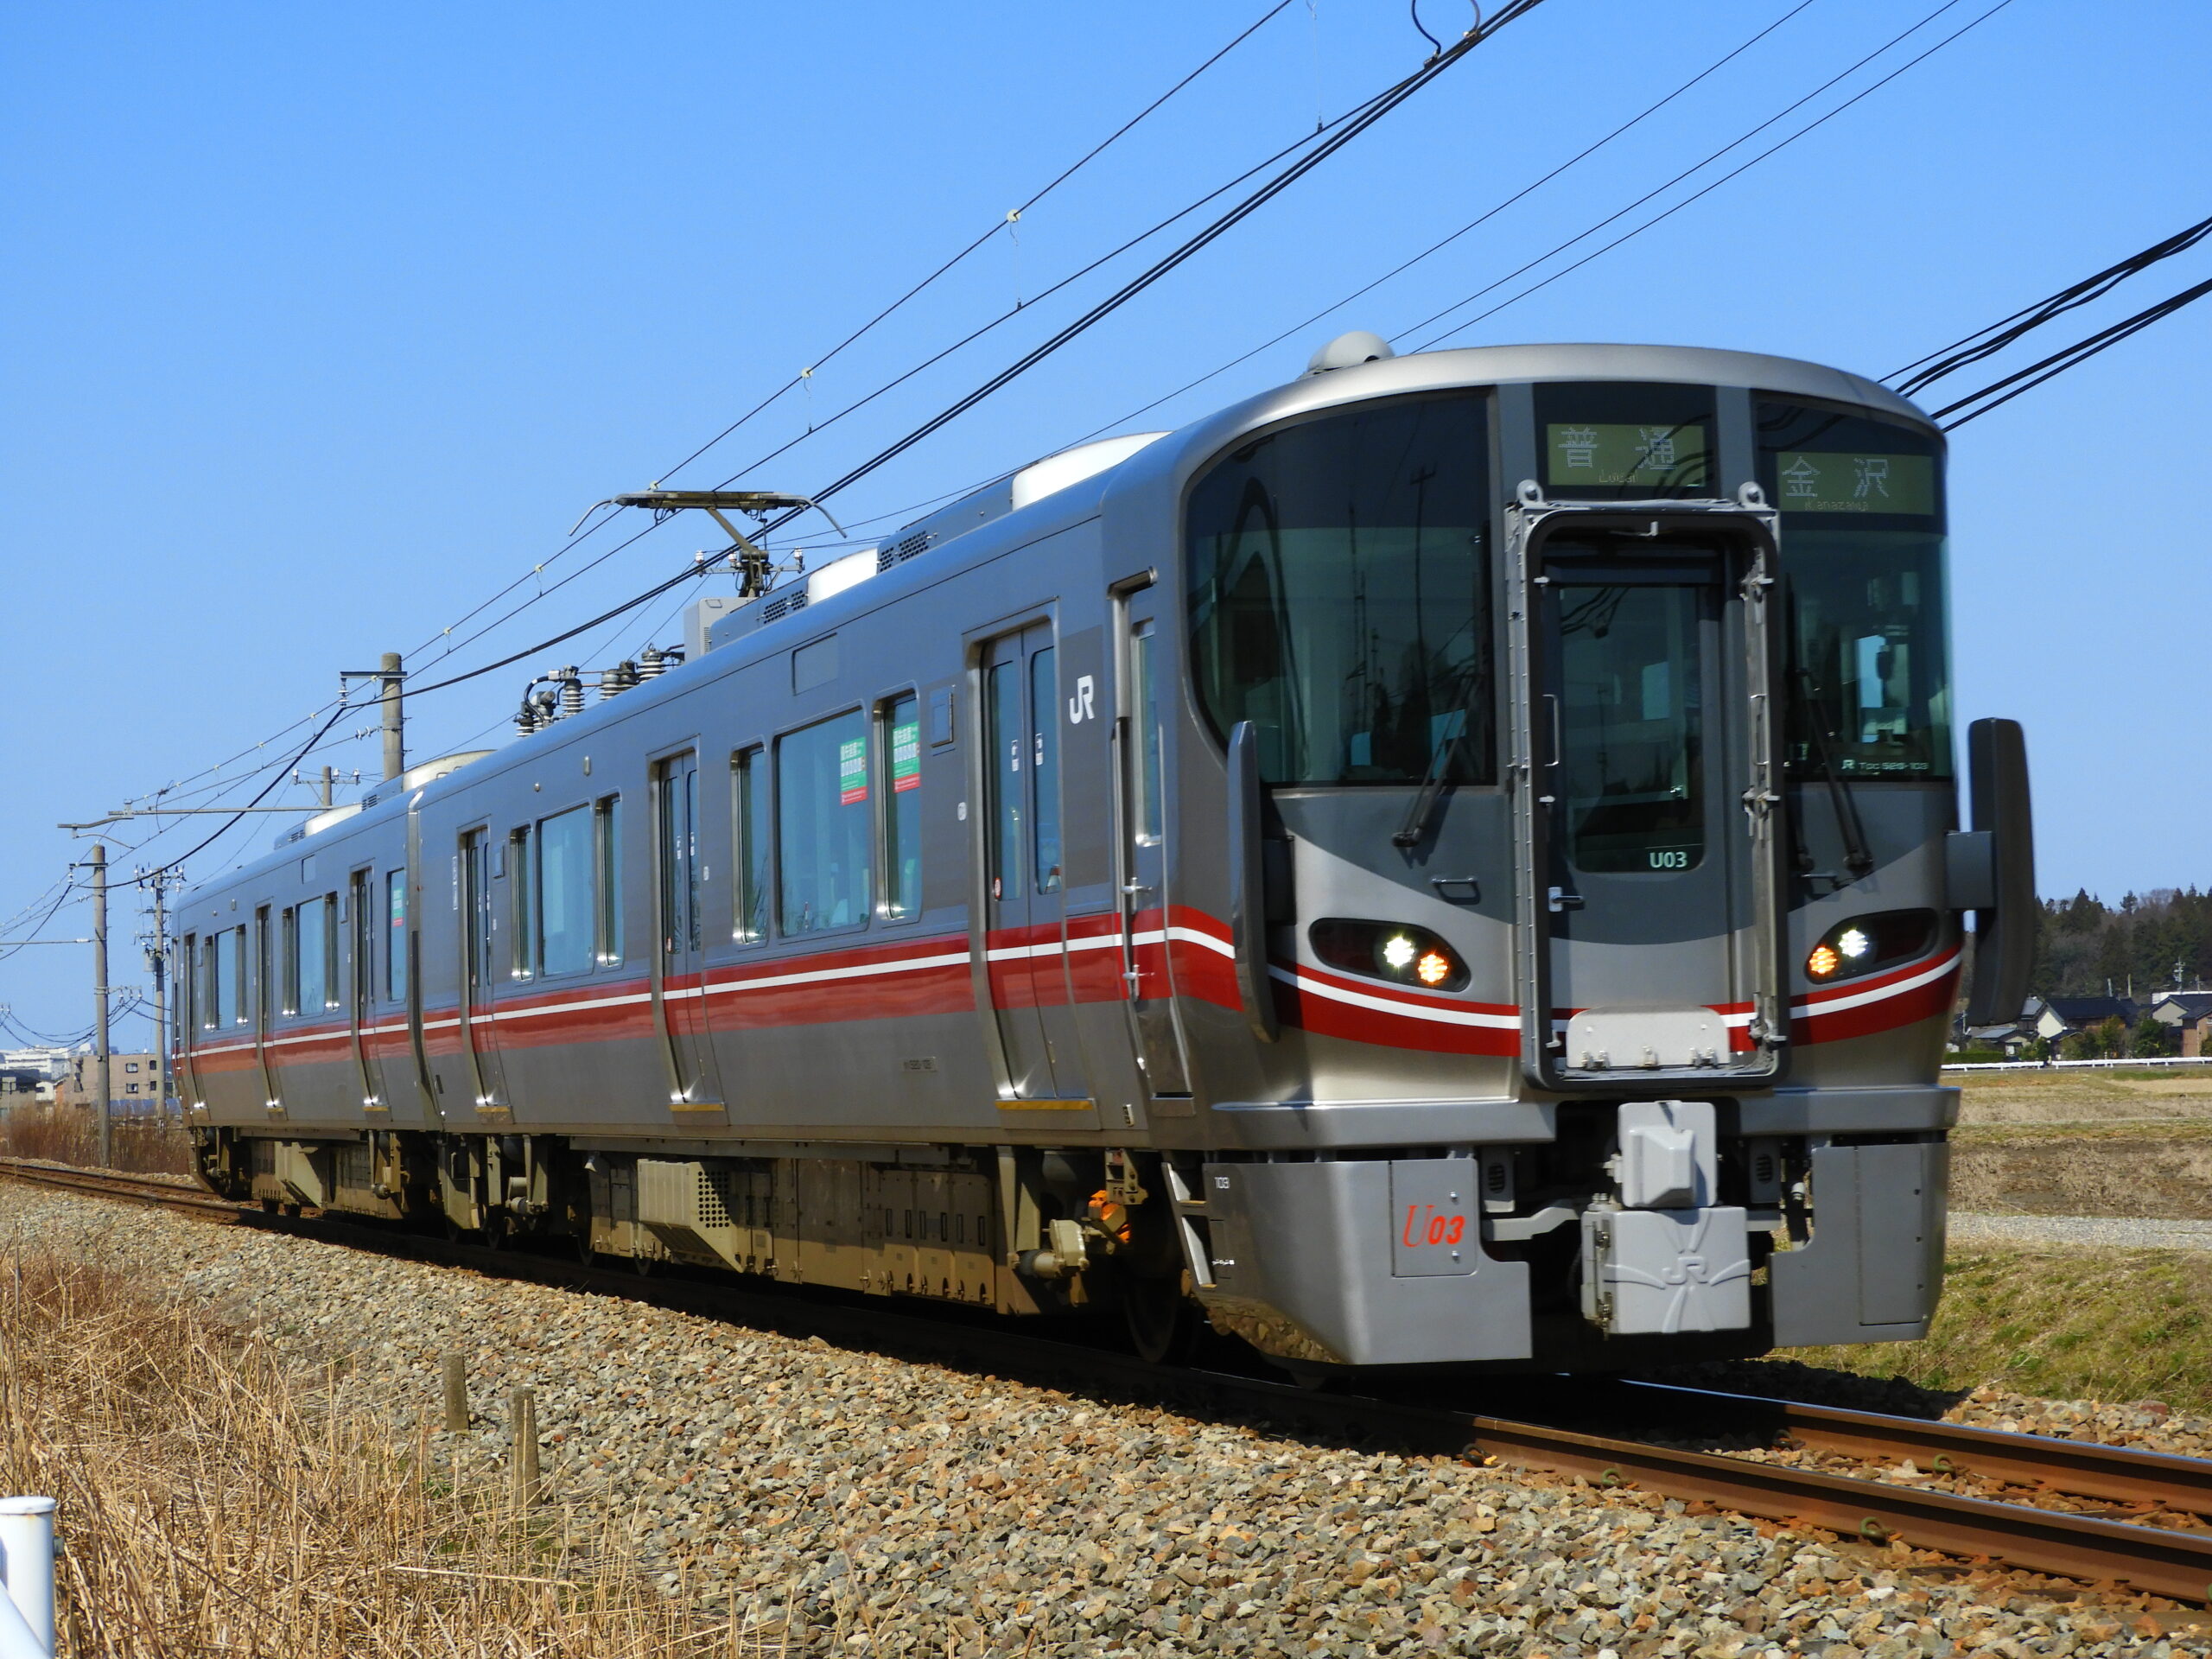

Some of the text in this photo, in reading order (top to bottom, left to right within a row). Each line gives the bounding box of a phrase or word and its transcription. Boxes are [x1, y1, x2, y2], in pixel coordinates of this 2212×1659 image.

[1558, 426, 1675, 470] 普通
[1782, 456, 1889, 498] 金沢
[1069, 675, 1095, 724] JR
[1649, 851, 1688, 868] U03
[1402, 1204, 1466, 1248] U03
[1662, 1255, 1708, 1286] JR
